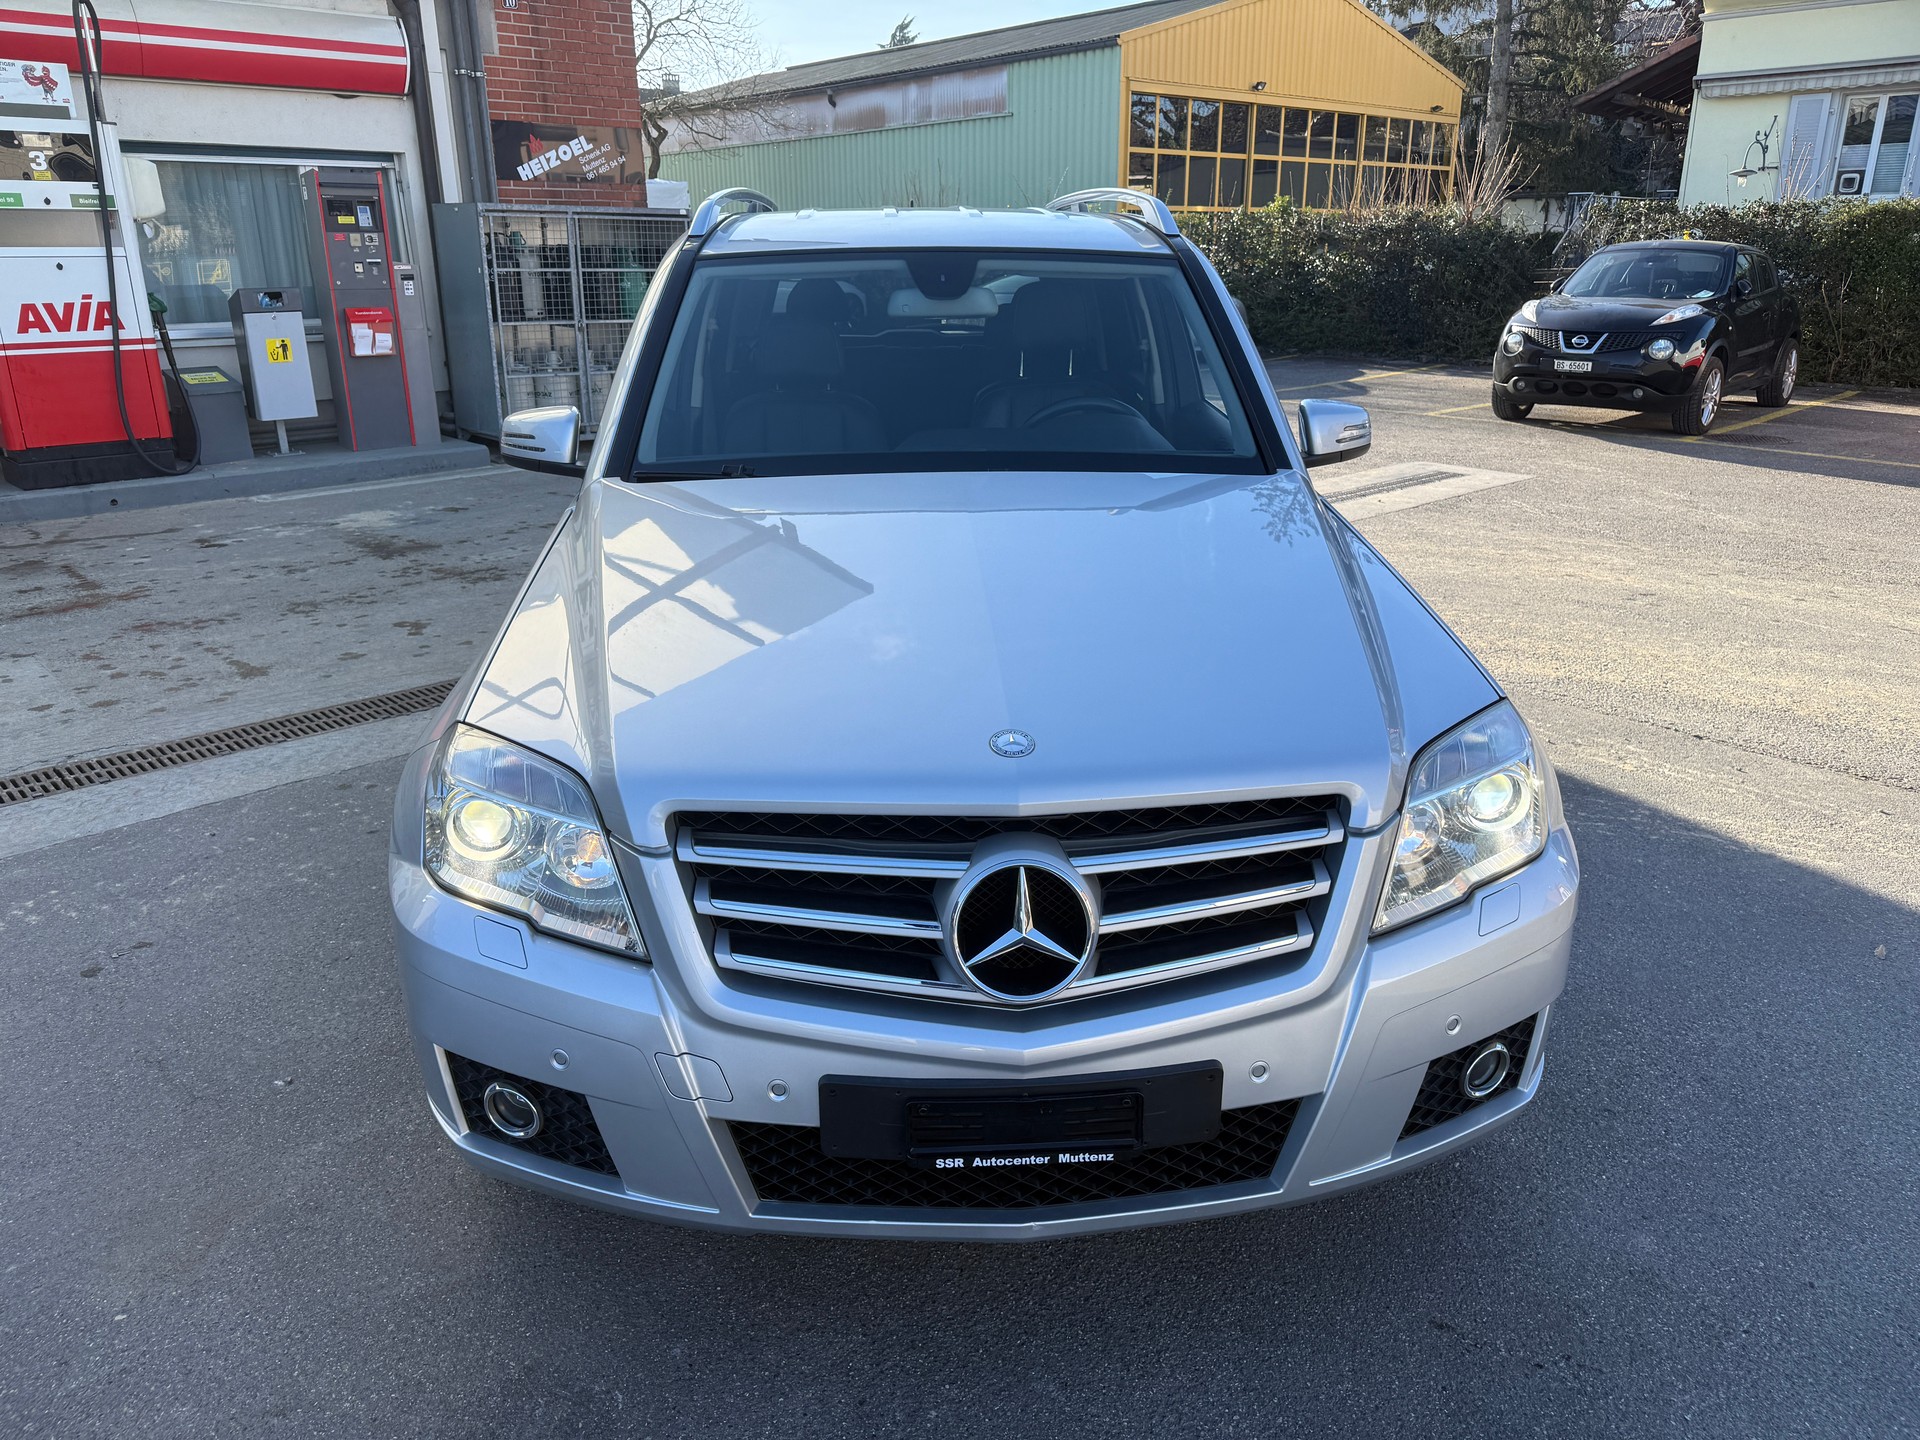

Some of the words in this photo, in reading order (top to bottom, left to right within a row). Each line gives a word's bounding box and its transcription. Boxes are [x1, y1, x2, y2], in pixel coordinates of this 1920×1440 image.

[28, 151, 48, 171] 3
[516, 135, 594, 181] HEIZOEL
[578, 148, 602, 165] Schenk
[600, 143, 611, 153] AG
[582, 157, 607, 173] Muttenz
[585, 170, 599, 181] 061
[598, 164, 610, 174] 465
[610, 160, 618, 169] 94
[618, 155, 626, 165] 94
[935, 1158, 965, 1169] SSR
[972, 1155, 1051, 1167] Autocenter
[1058, 1153, 1115, 1164] Muttenz
